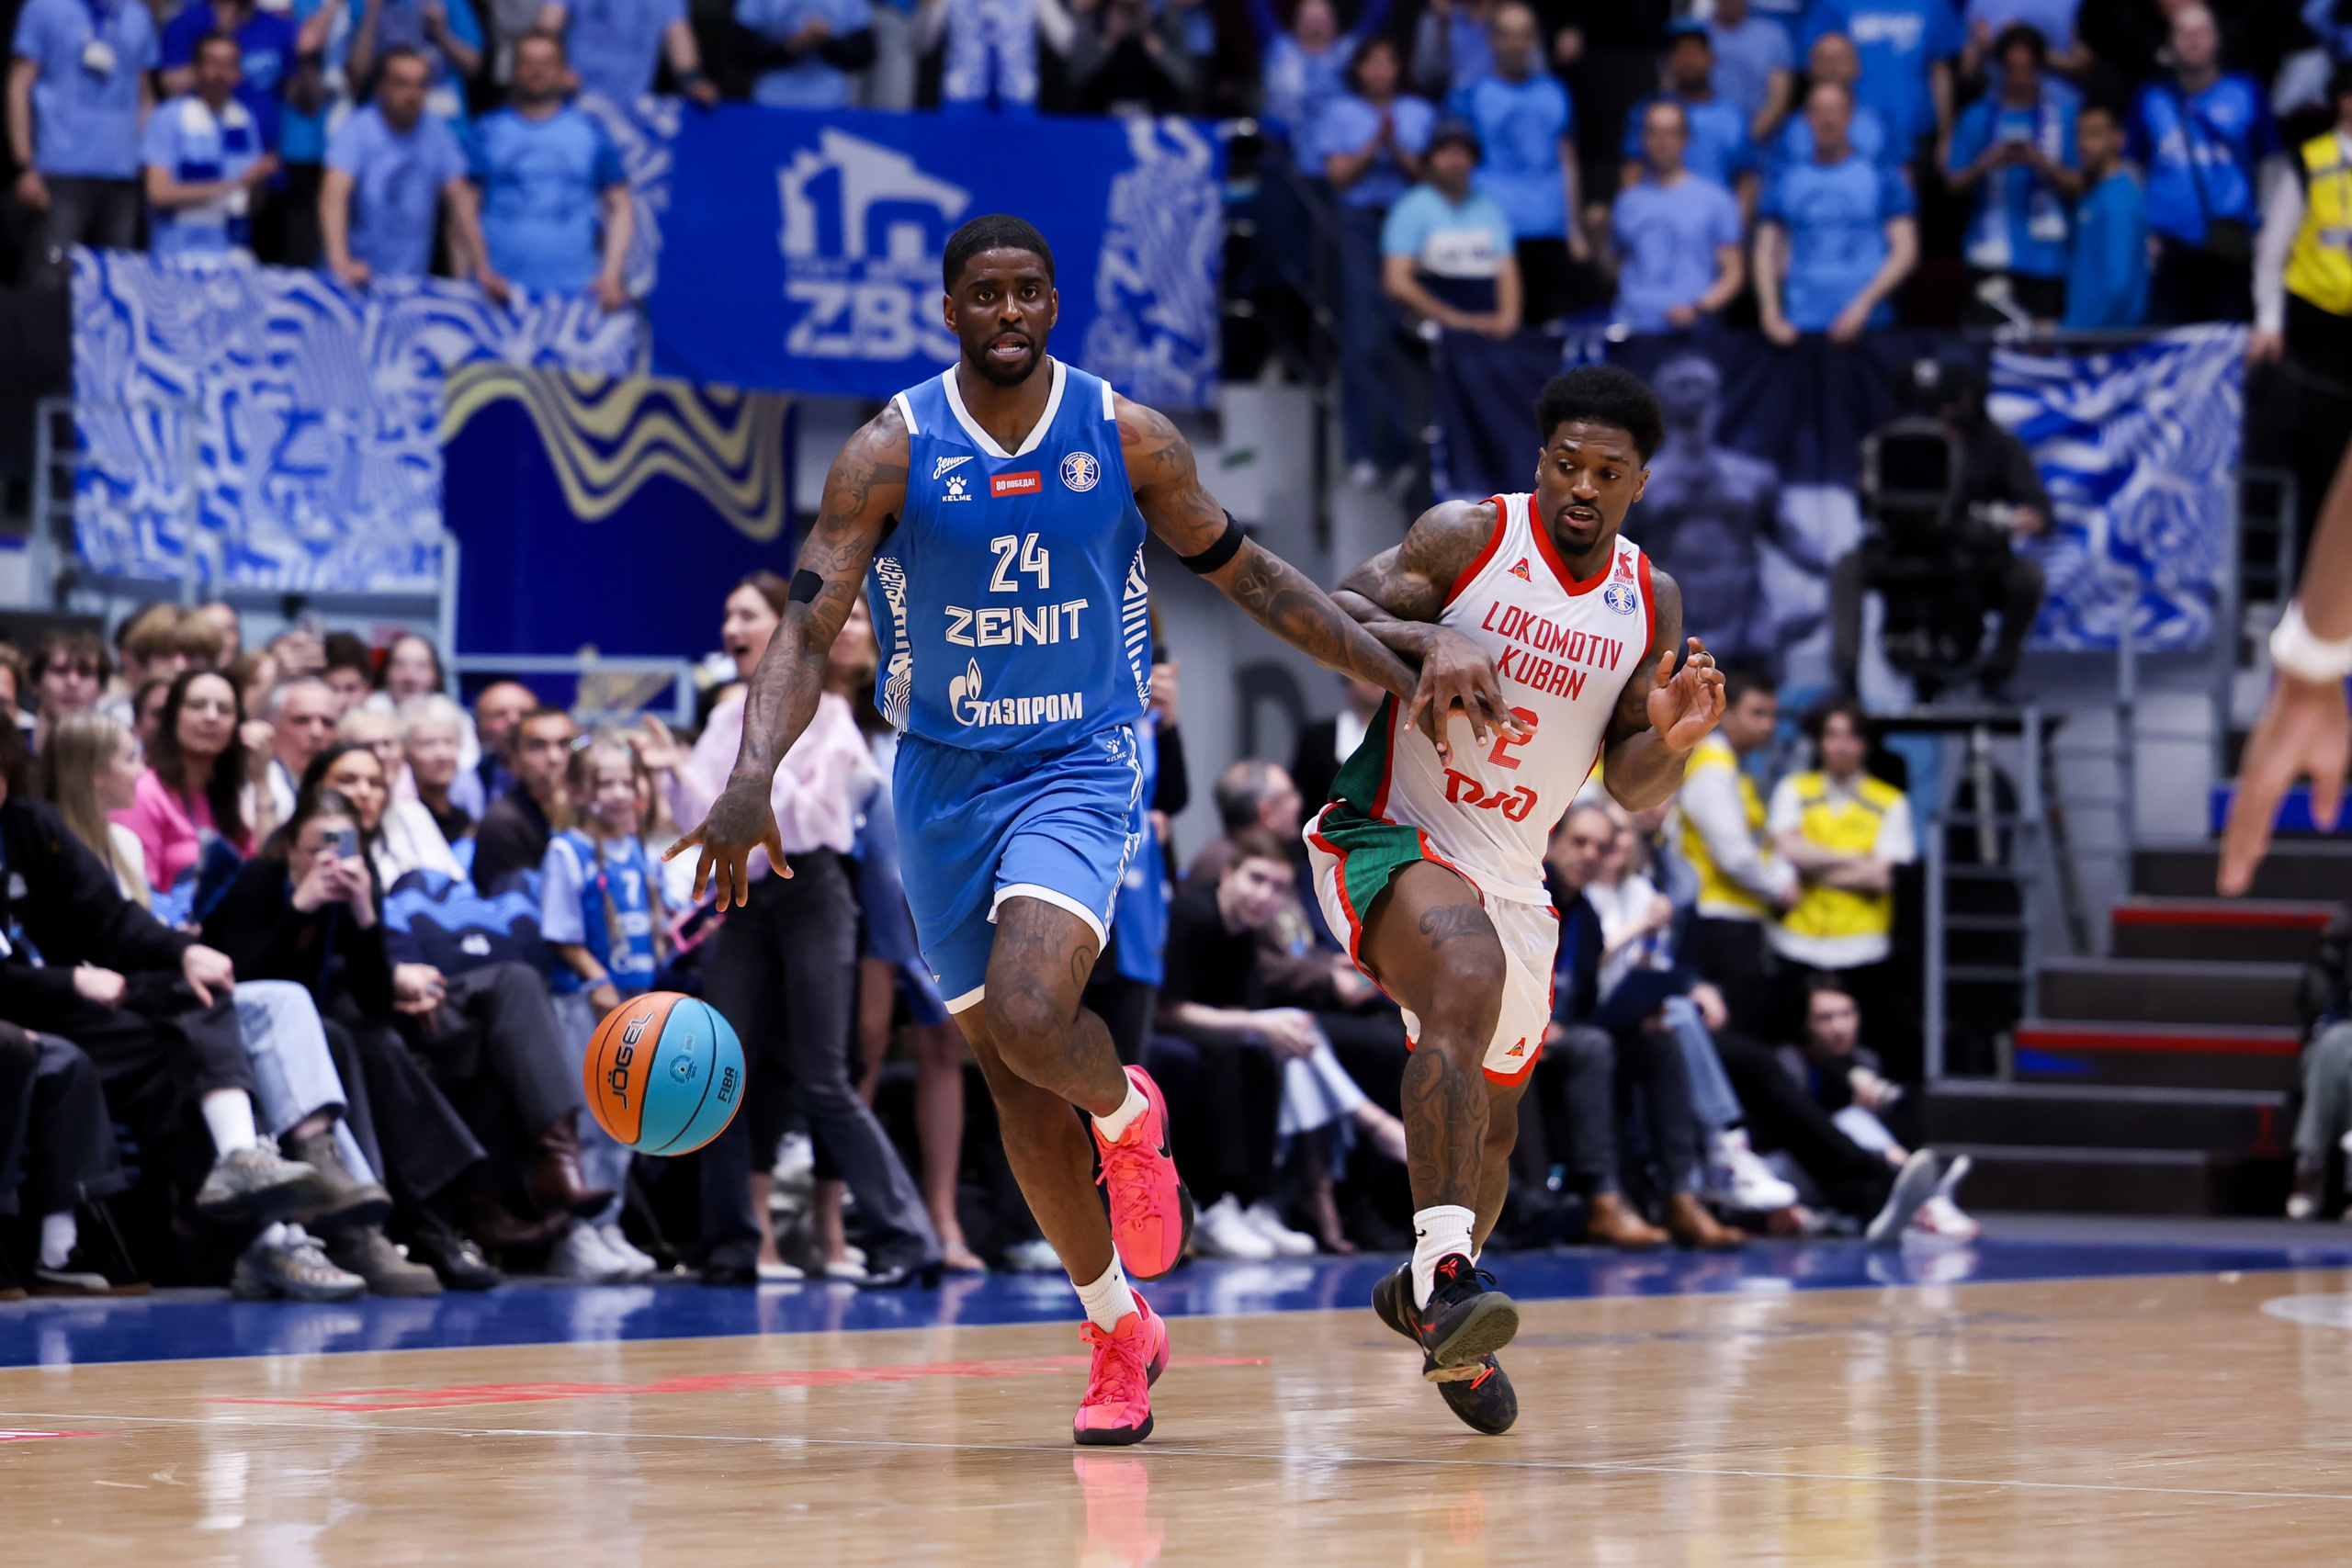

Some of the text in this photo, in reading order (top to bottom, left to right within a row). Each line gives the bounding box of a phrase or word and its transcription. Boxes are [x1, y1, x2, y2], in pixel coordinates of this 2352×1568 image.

[996, 478, 1035, 491] 80 ПОБЕДА!
[989, 532, 1050, 592] 24
[944, 598, 1089, 648] ZENIT
[1481, 601, 1623, 671] LOKOMOTIV
[1498, 645, 1587, 701] KUBAN
[1106, 750, 1127, 763] KELME
[1487, 706, 1539, 770] 2
[607, 1011, 655, 1111] JÖGEL
[718, 1066, 735, 1102] FIBA
